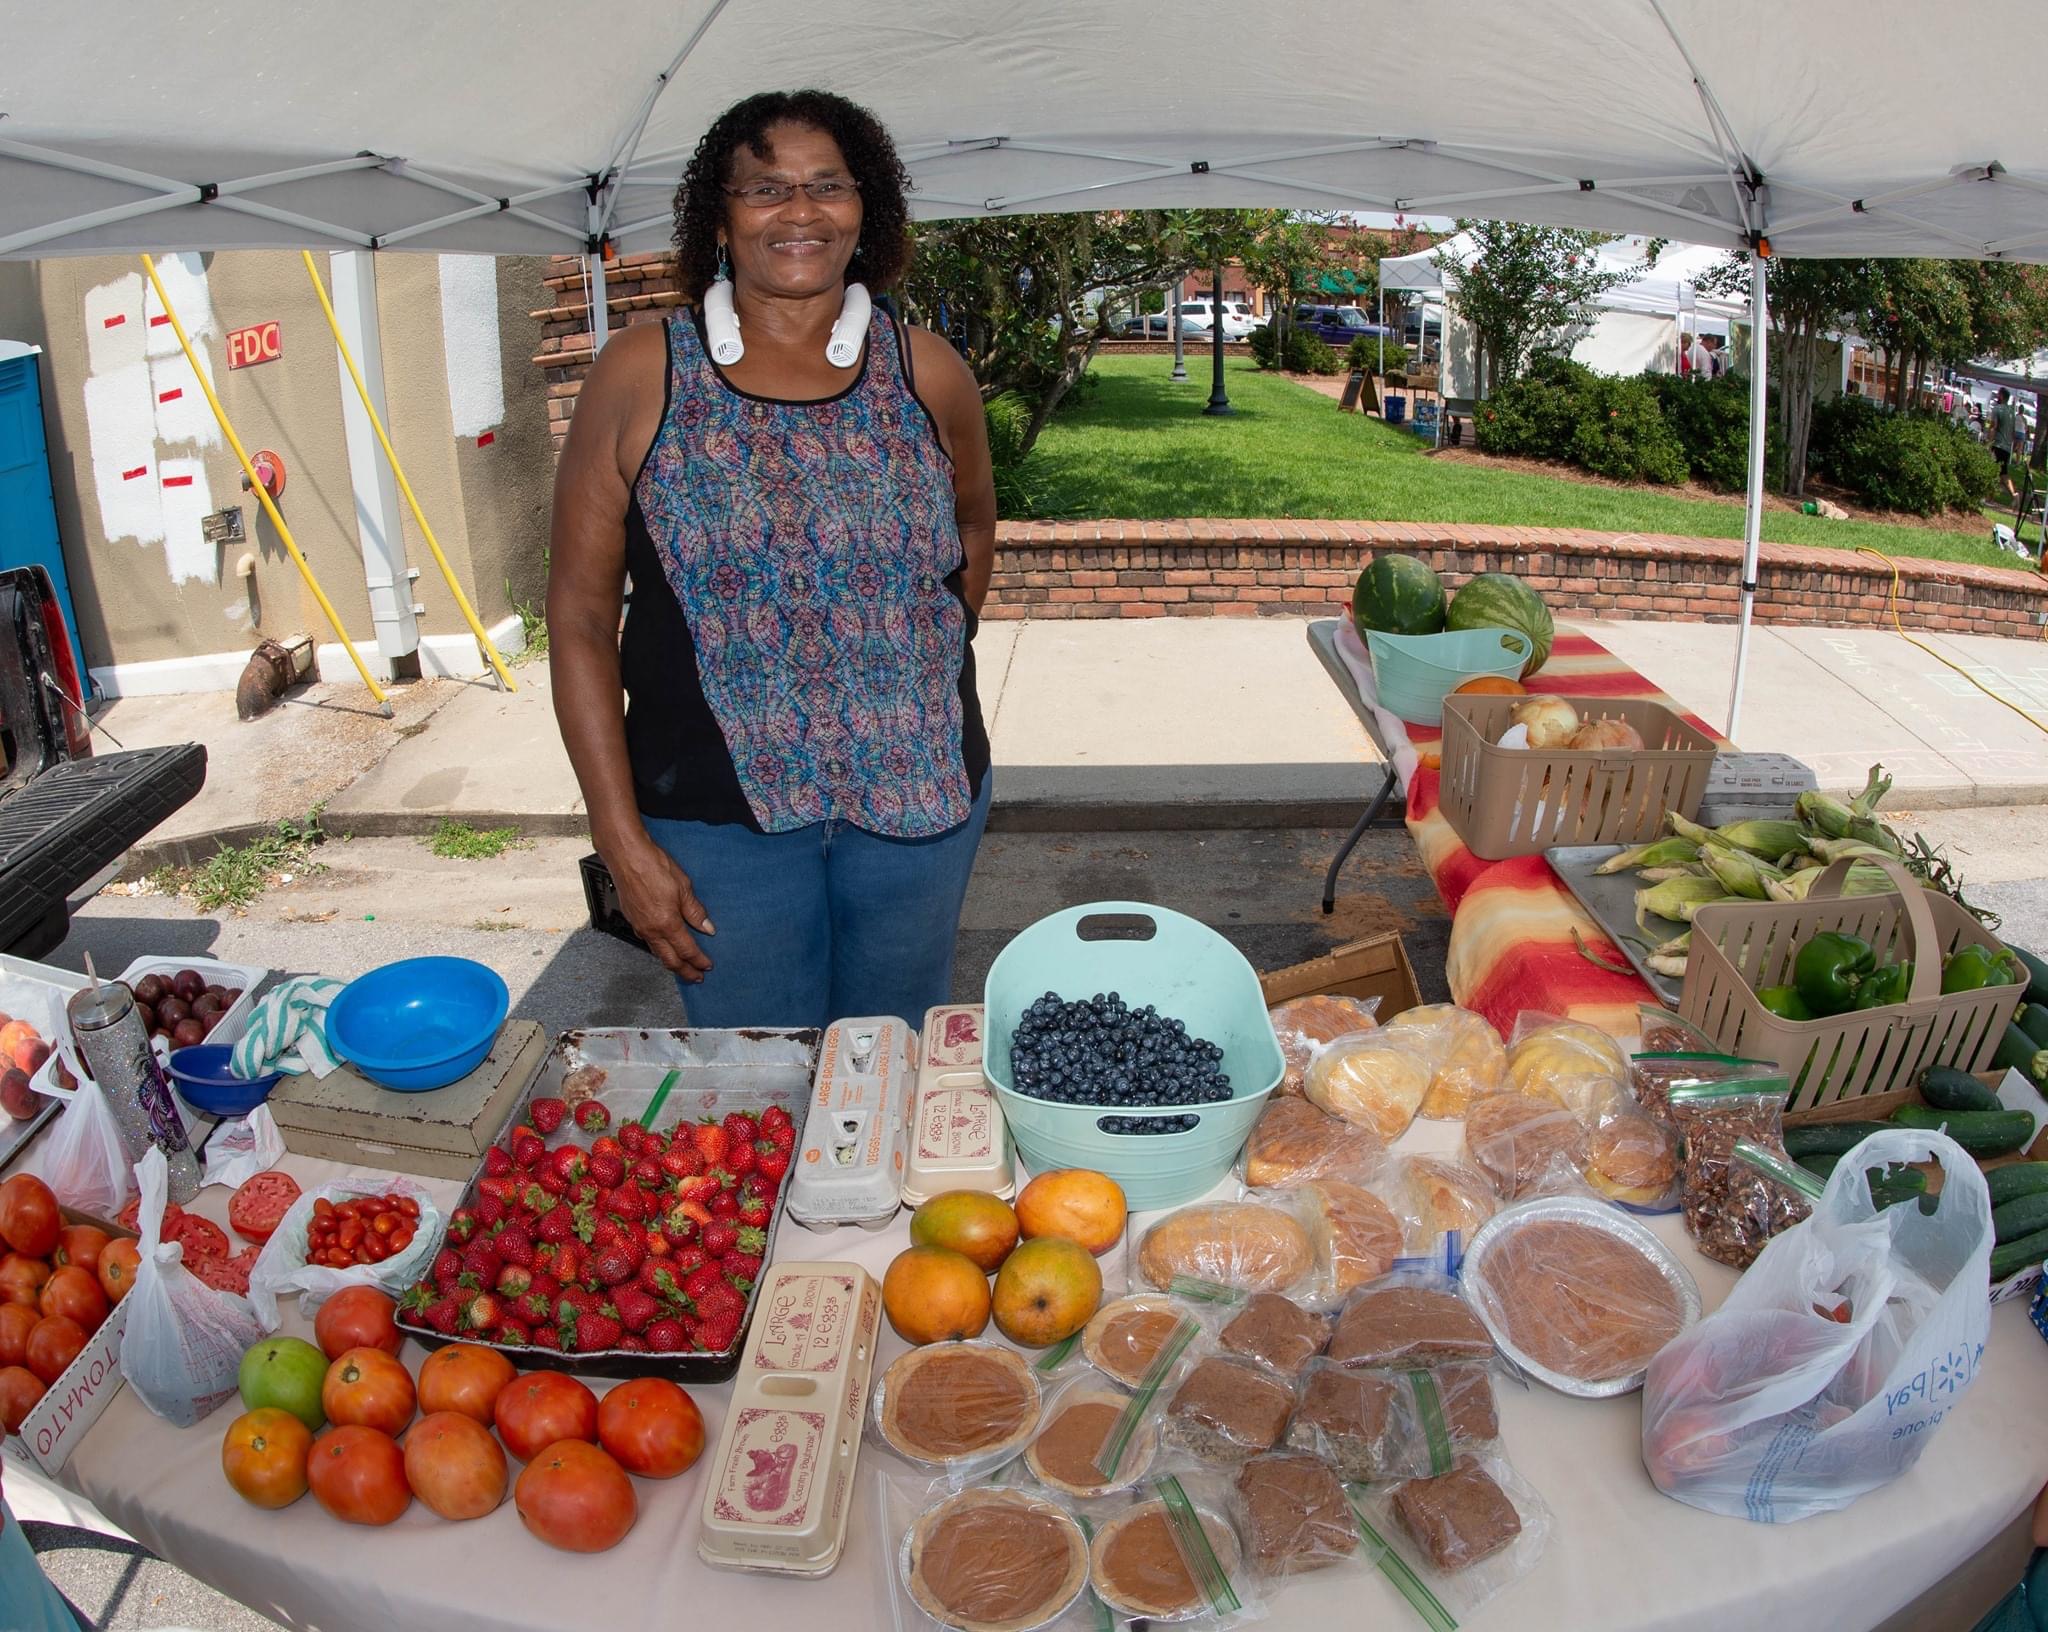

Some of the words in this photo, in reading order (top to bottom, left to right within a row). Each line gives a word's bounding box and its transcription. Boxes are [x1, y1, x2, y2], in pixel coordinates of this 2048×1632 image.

[230, 323, 278, 367] FDC
[828, 1027, 841, 1049] EGGS
[822, 1051, 837, 1079] BROWN
[817, 1081, 832, 1108] LARGE
[933, 1104, 947, 1113] 12
[970, 1104, 987, 1141] LARGE
[803, 1279, 818, 1308] BROWN
[765, 1295, 797, 1346] LARGE
[788, 1343, 804, 1368] Grade
[813, 1336, 829, 1348] 12
[36, 1346, 118, 1456] TOMATO
[728, 1473, 736, 1492] Farm
[737, 1433, 750, 1455] Brown
[792, 1467, 809, 1502] Country
